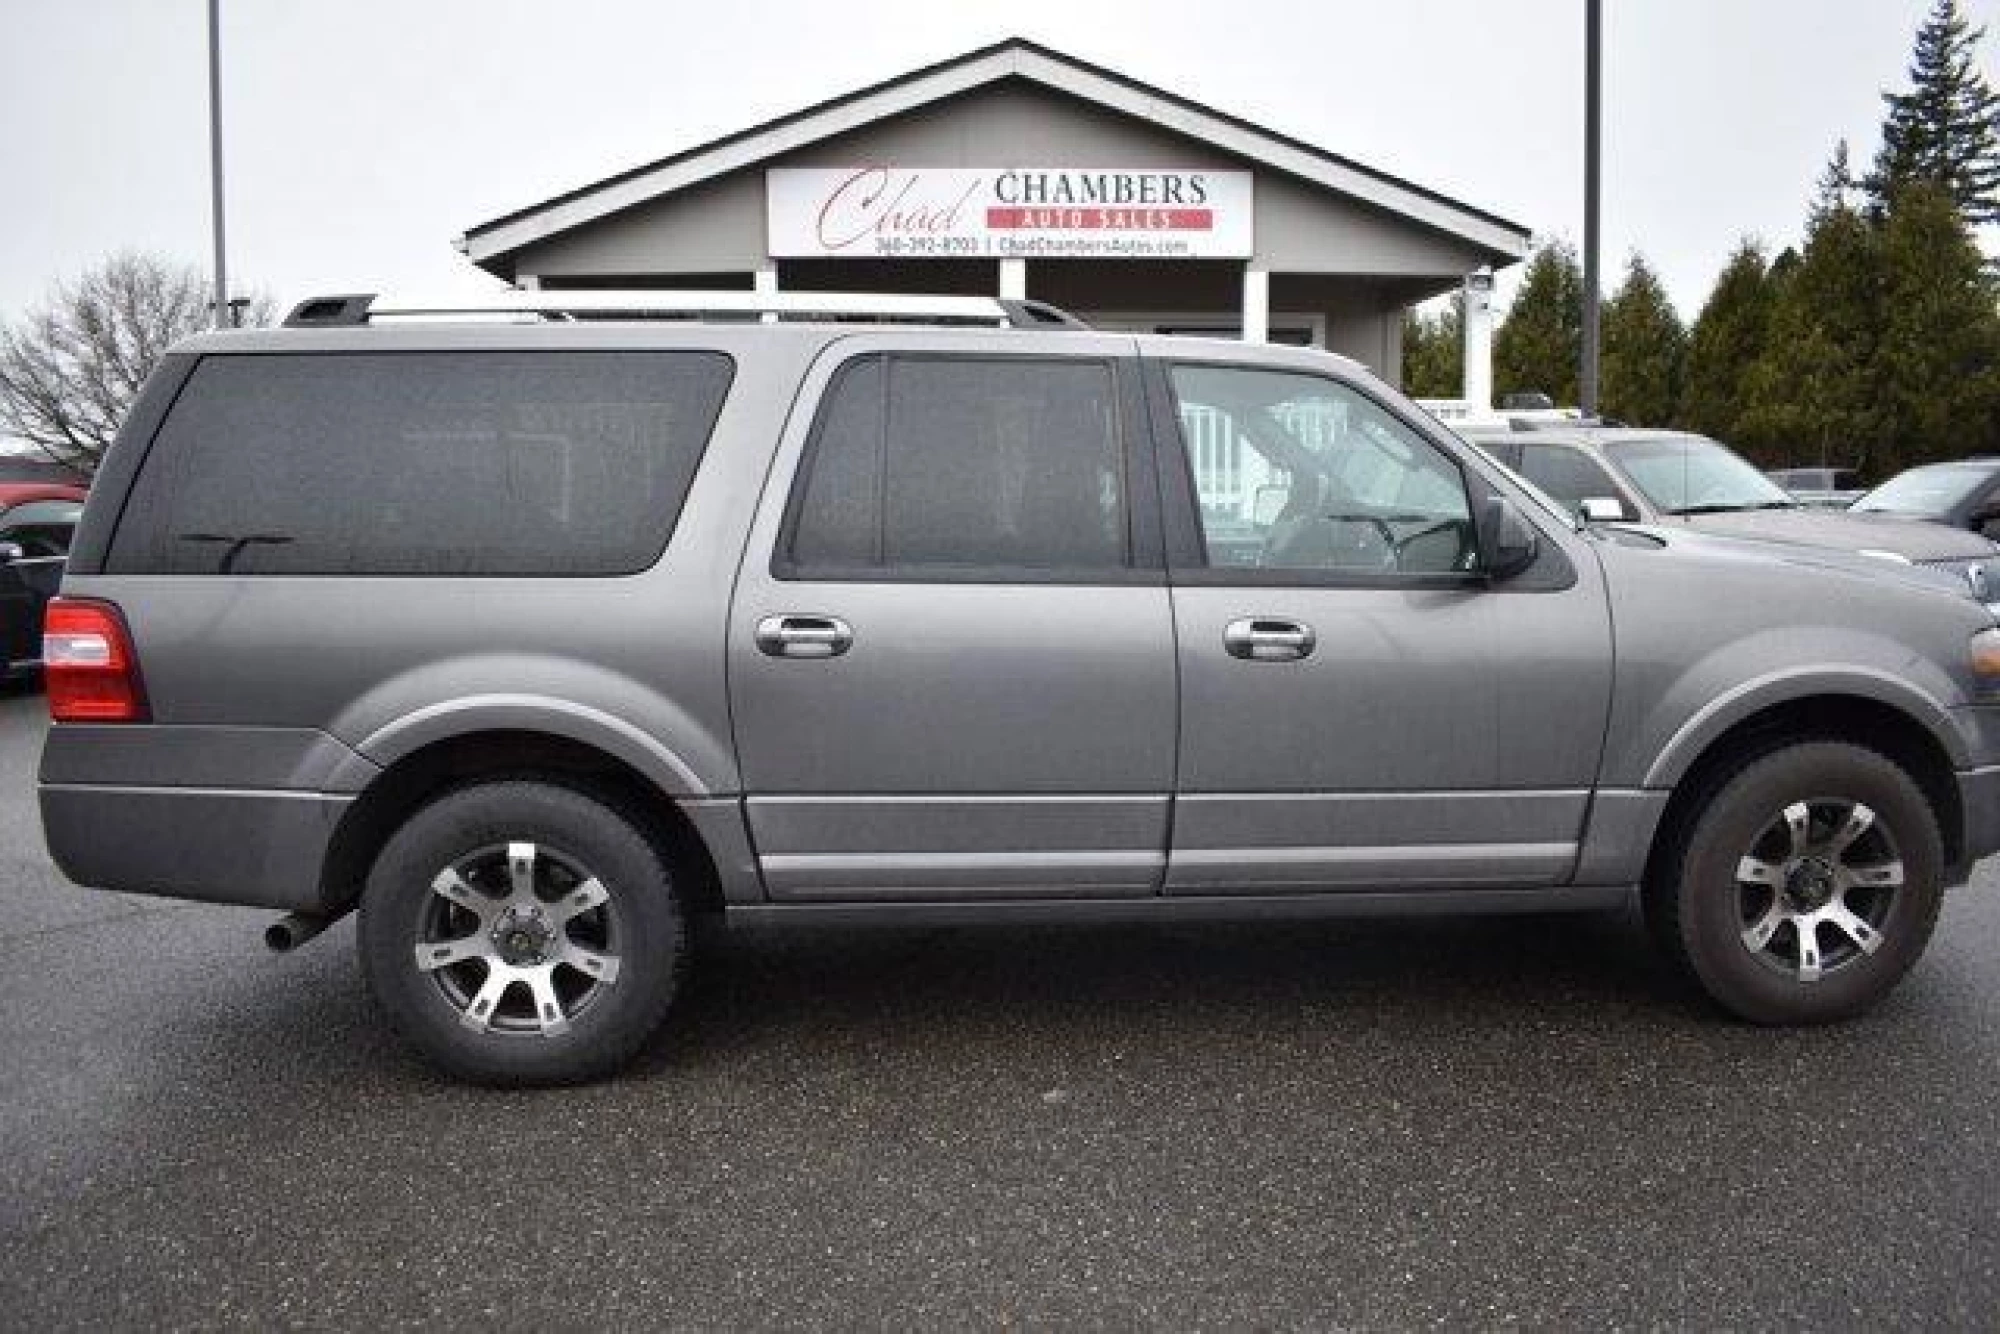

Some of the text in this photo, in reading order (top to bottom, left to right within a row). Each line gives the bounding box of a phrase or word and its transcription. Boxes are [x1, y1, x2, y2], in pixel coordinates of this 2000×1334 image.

[995, 173, 1207, 204] CHAMBERS
[817, 165, 981, 248] Chad
[1021, 210, 1171, 228] AUTO SALES
